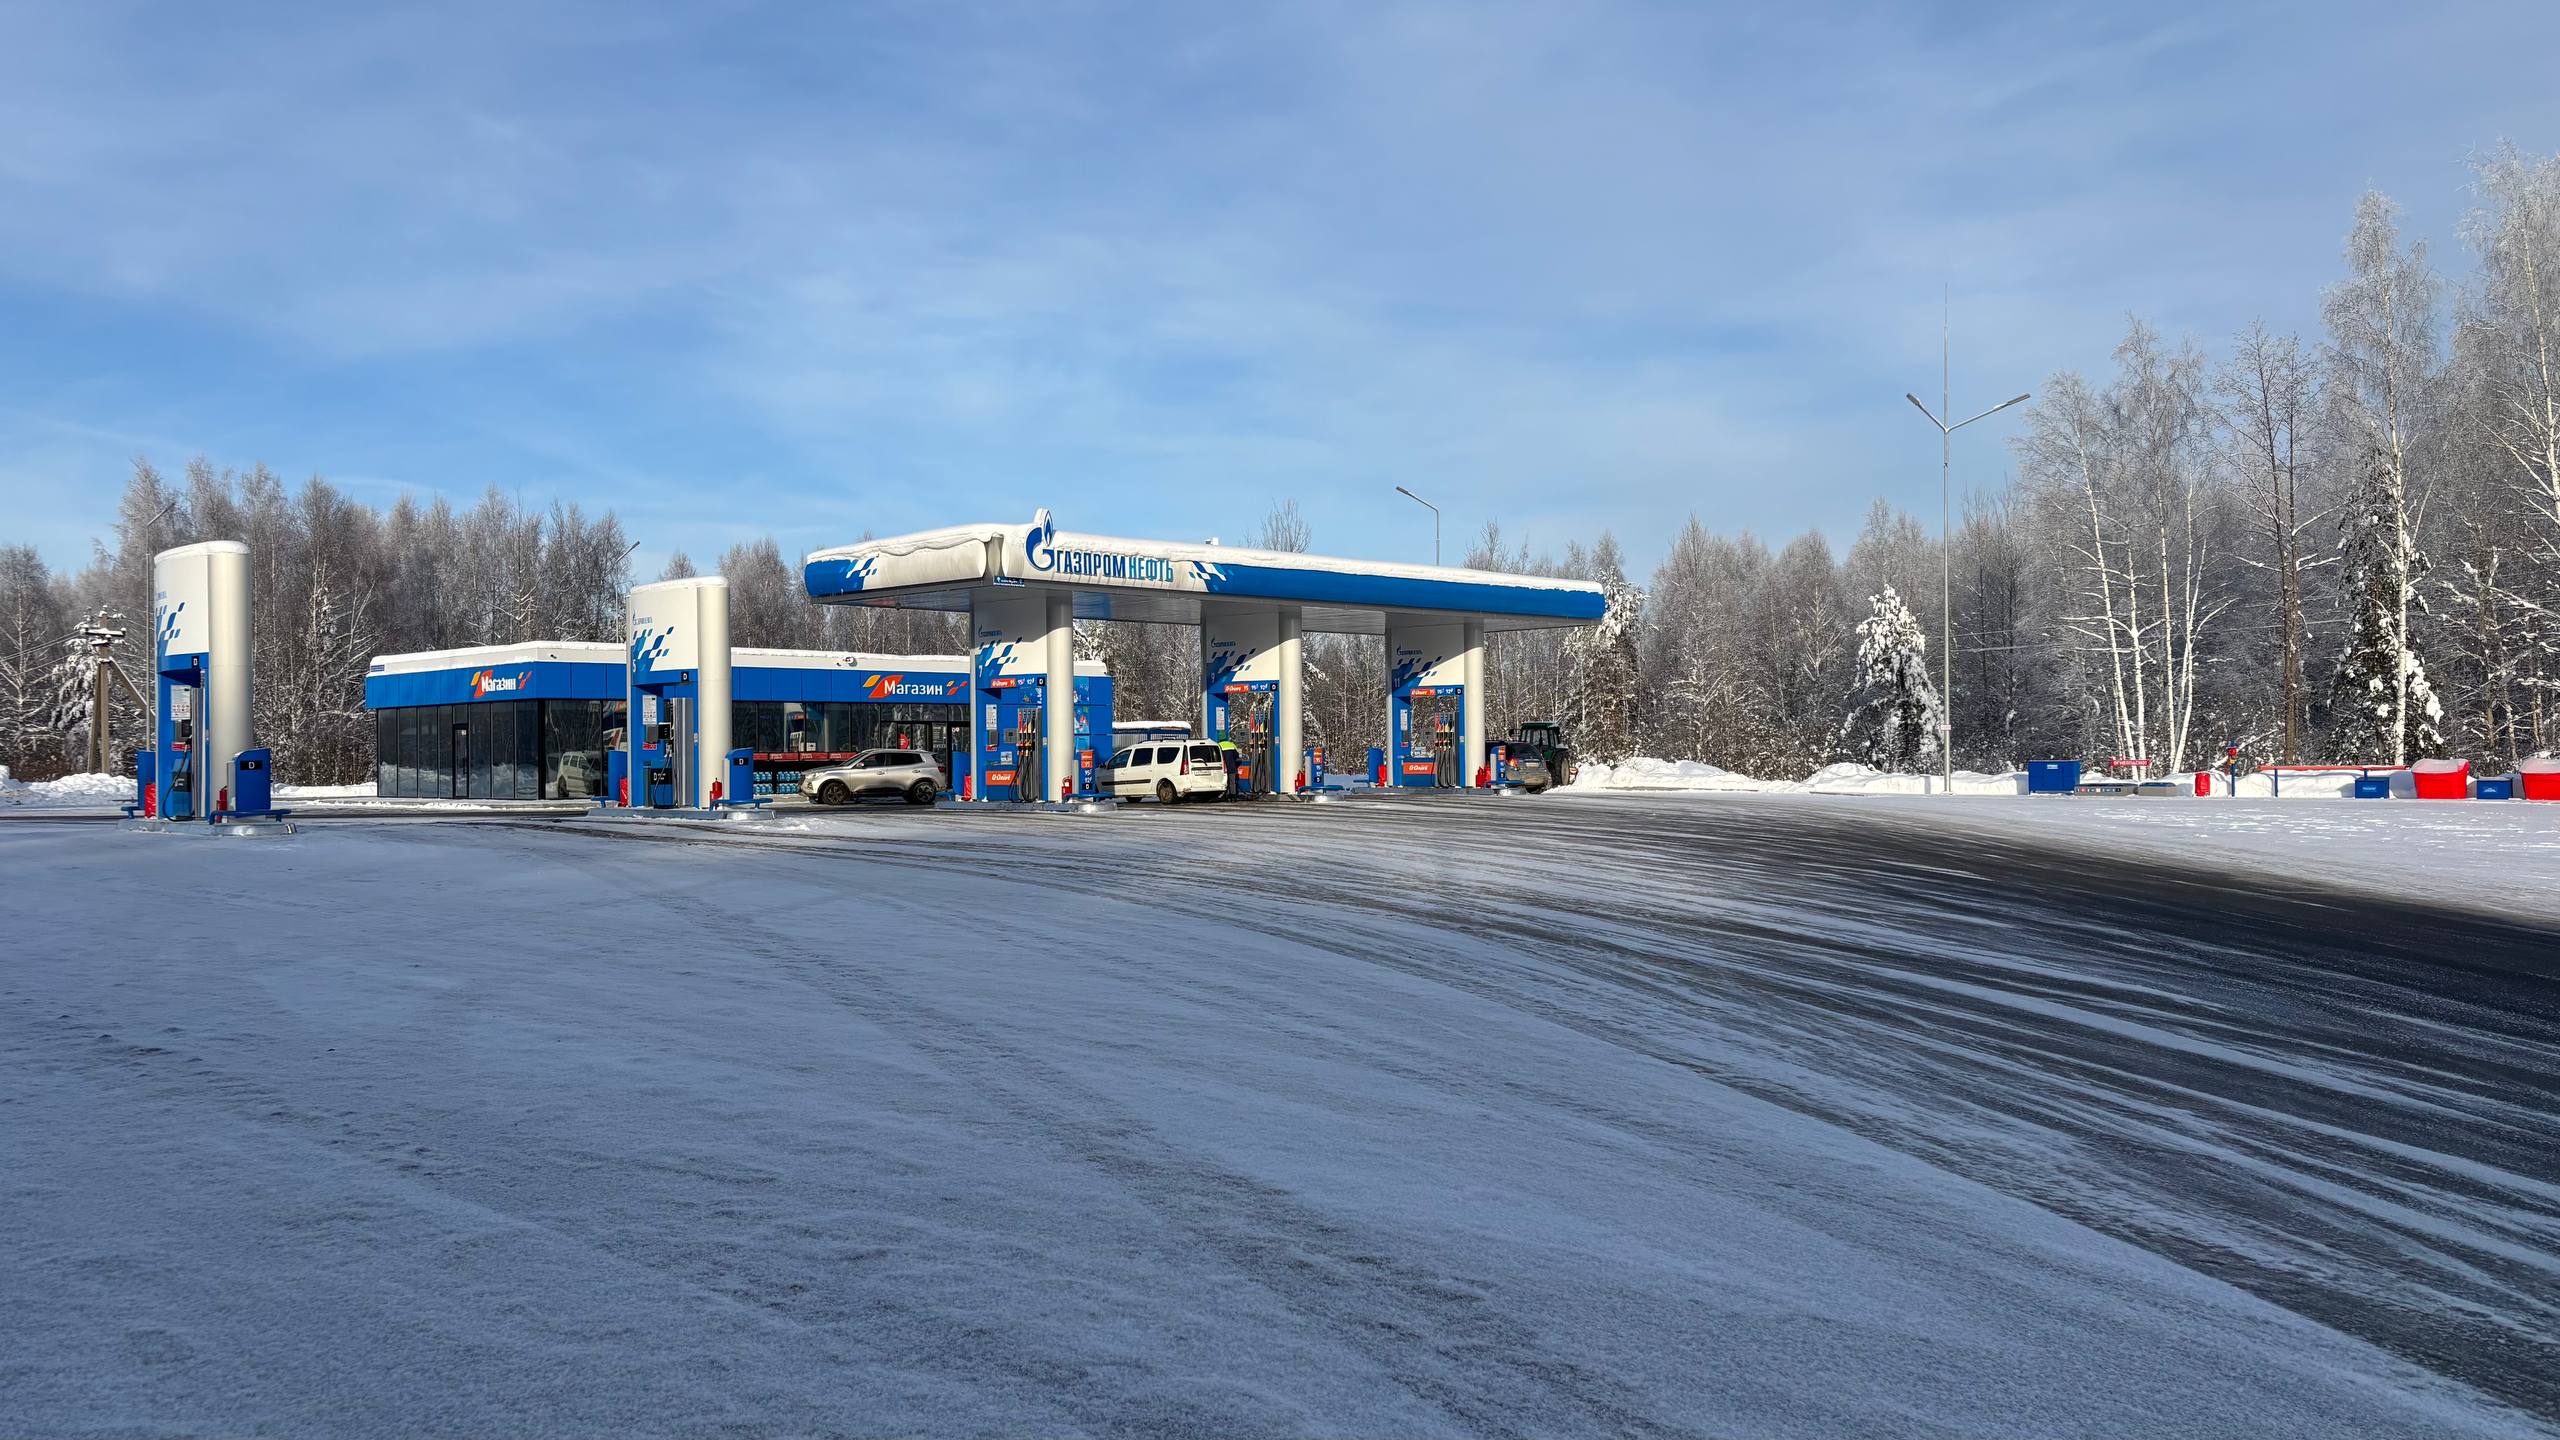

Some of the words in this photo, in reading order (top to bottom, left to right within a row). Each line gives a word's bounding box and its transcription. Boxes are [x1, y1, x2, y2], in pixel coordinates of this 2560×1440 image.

[1055, 549, 1174, 583] ГАЗПРОМНЕФТЬ
[481, 675, 516, 692] Магазин
[884, 680, 944, 695] Магазин
[248, 761, 256, 769] D
